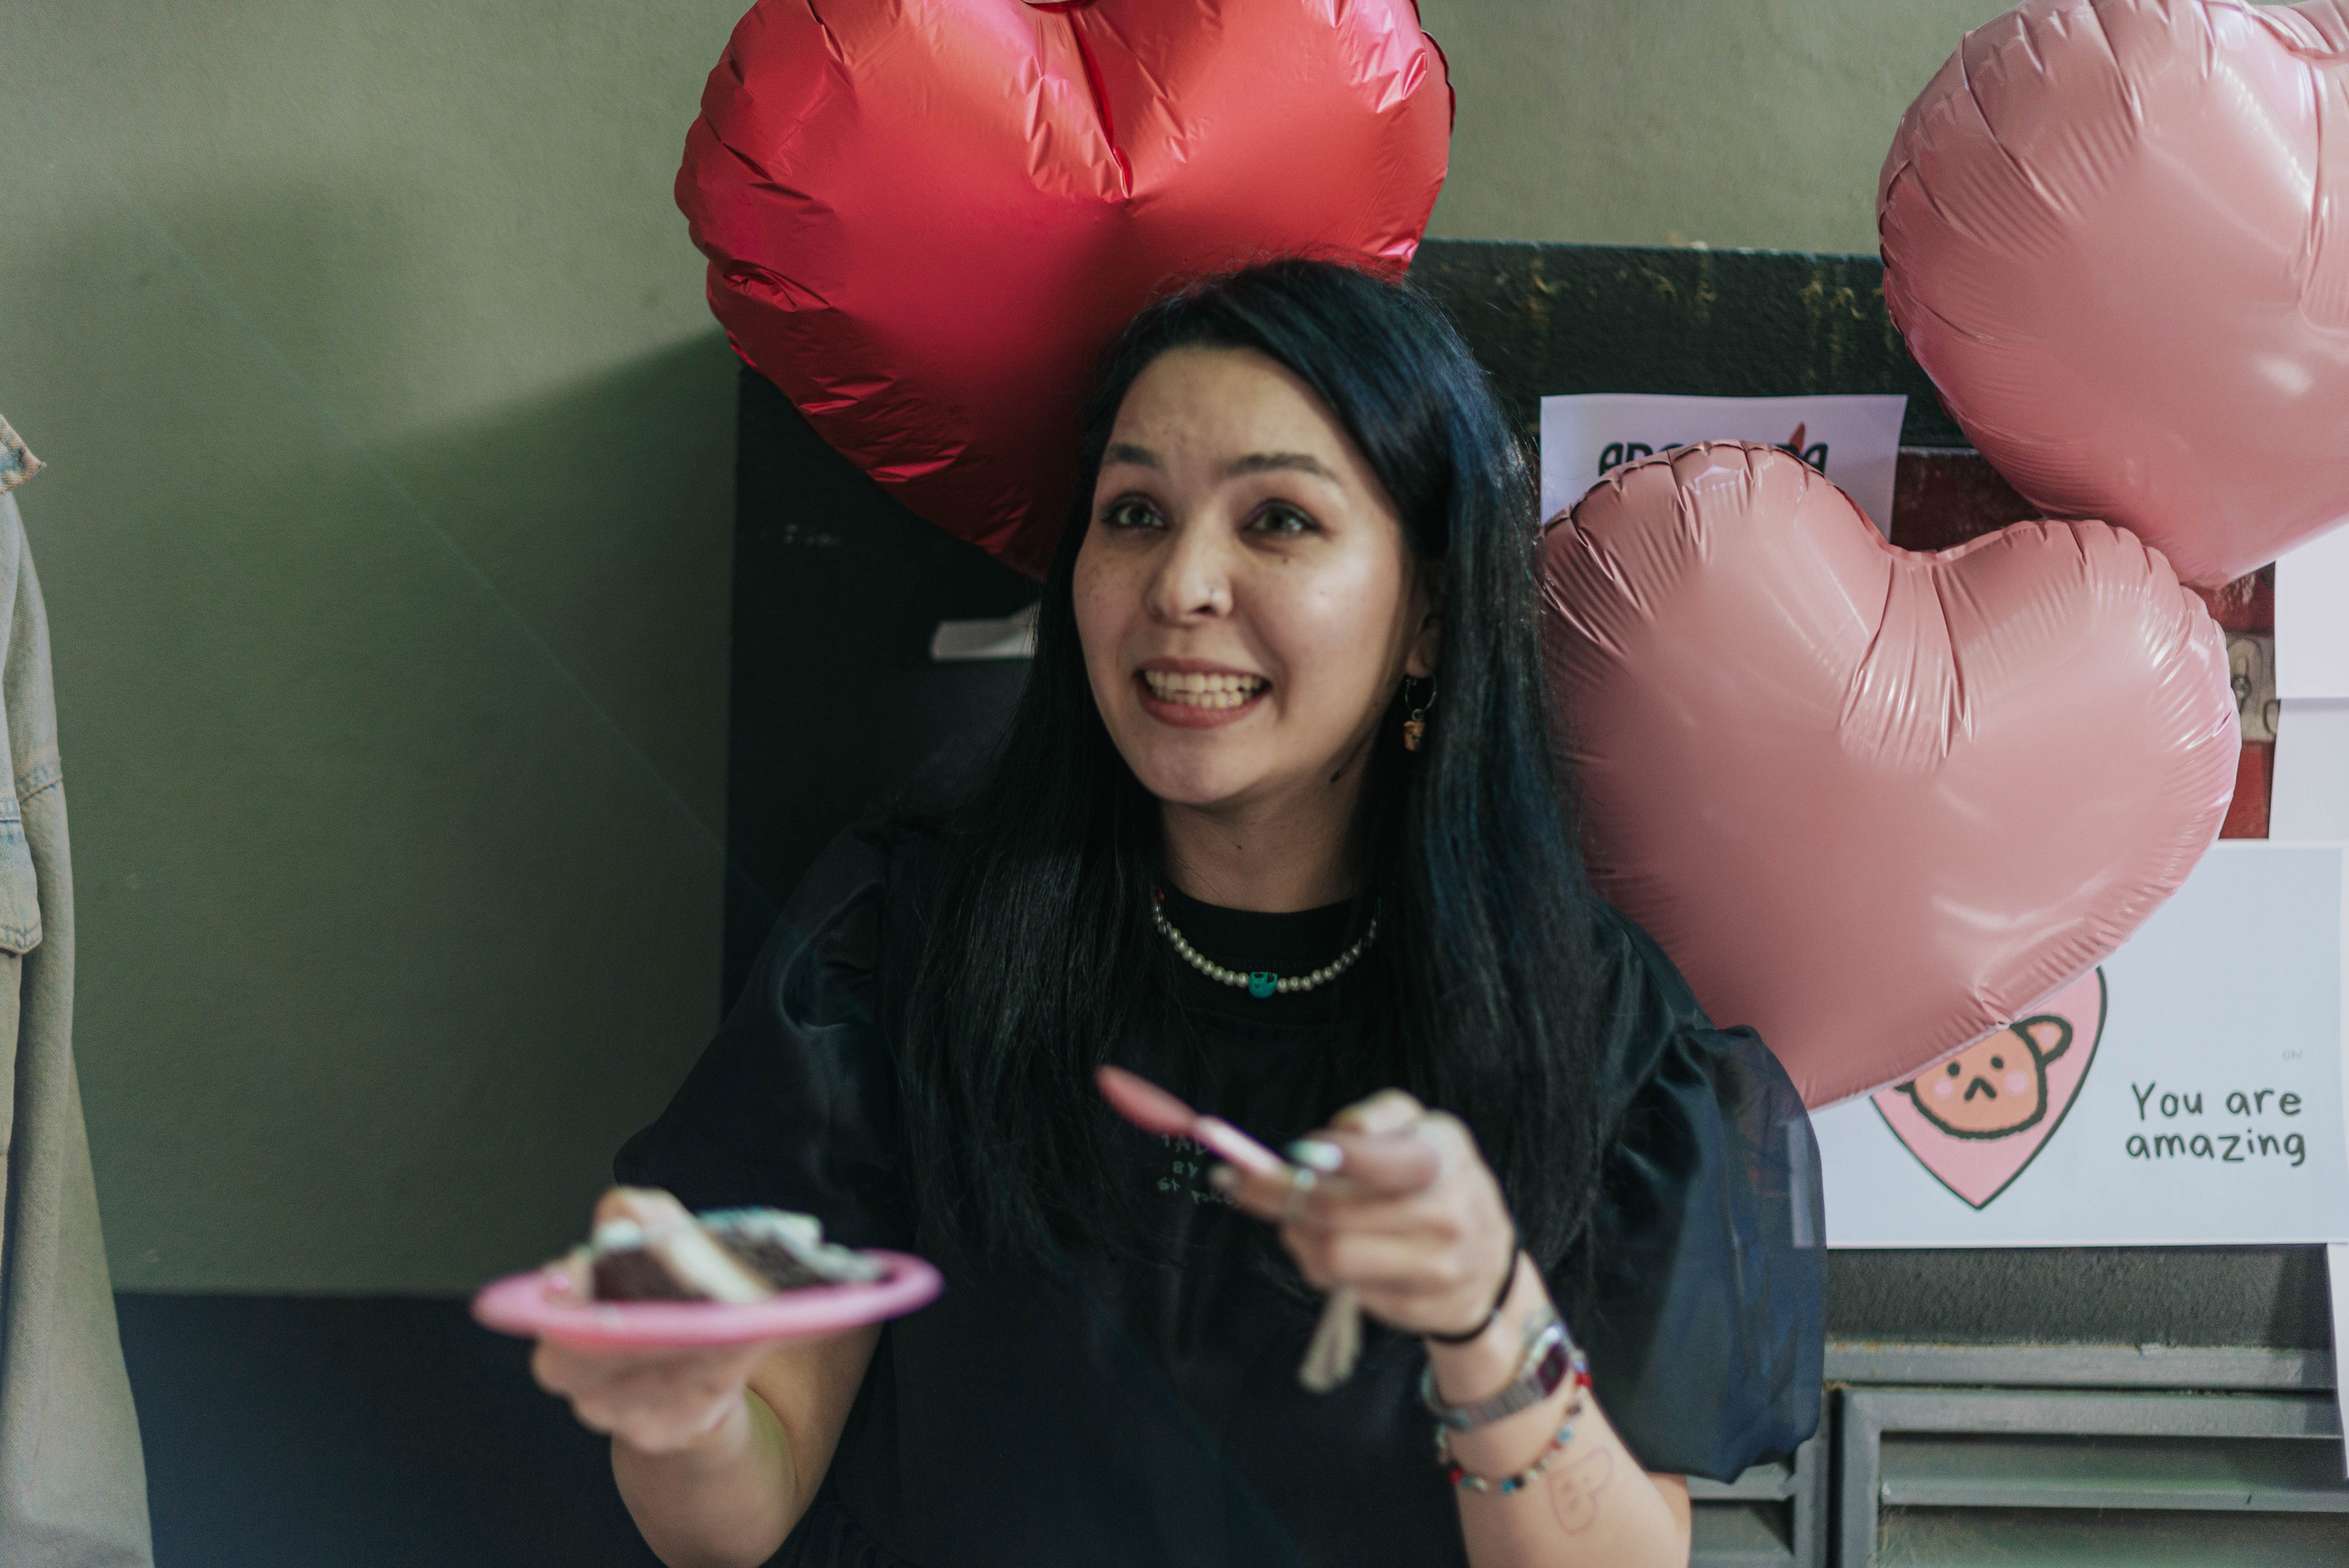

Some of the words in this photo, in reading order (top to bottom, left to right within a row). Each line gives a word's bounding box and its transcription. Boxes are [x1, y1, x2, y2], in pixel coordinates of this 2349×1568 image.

[2132, 1081, 2202, 1121] You
[2225, 1088, 2302, 1116] are
[2125, 1128, 2306, 1167] amazing
